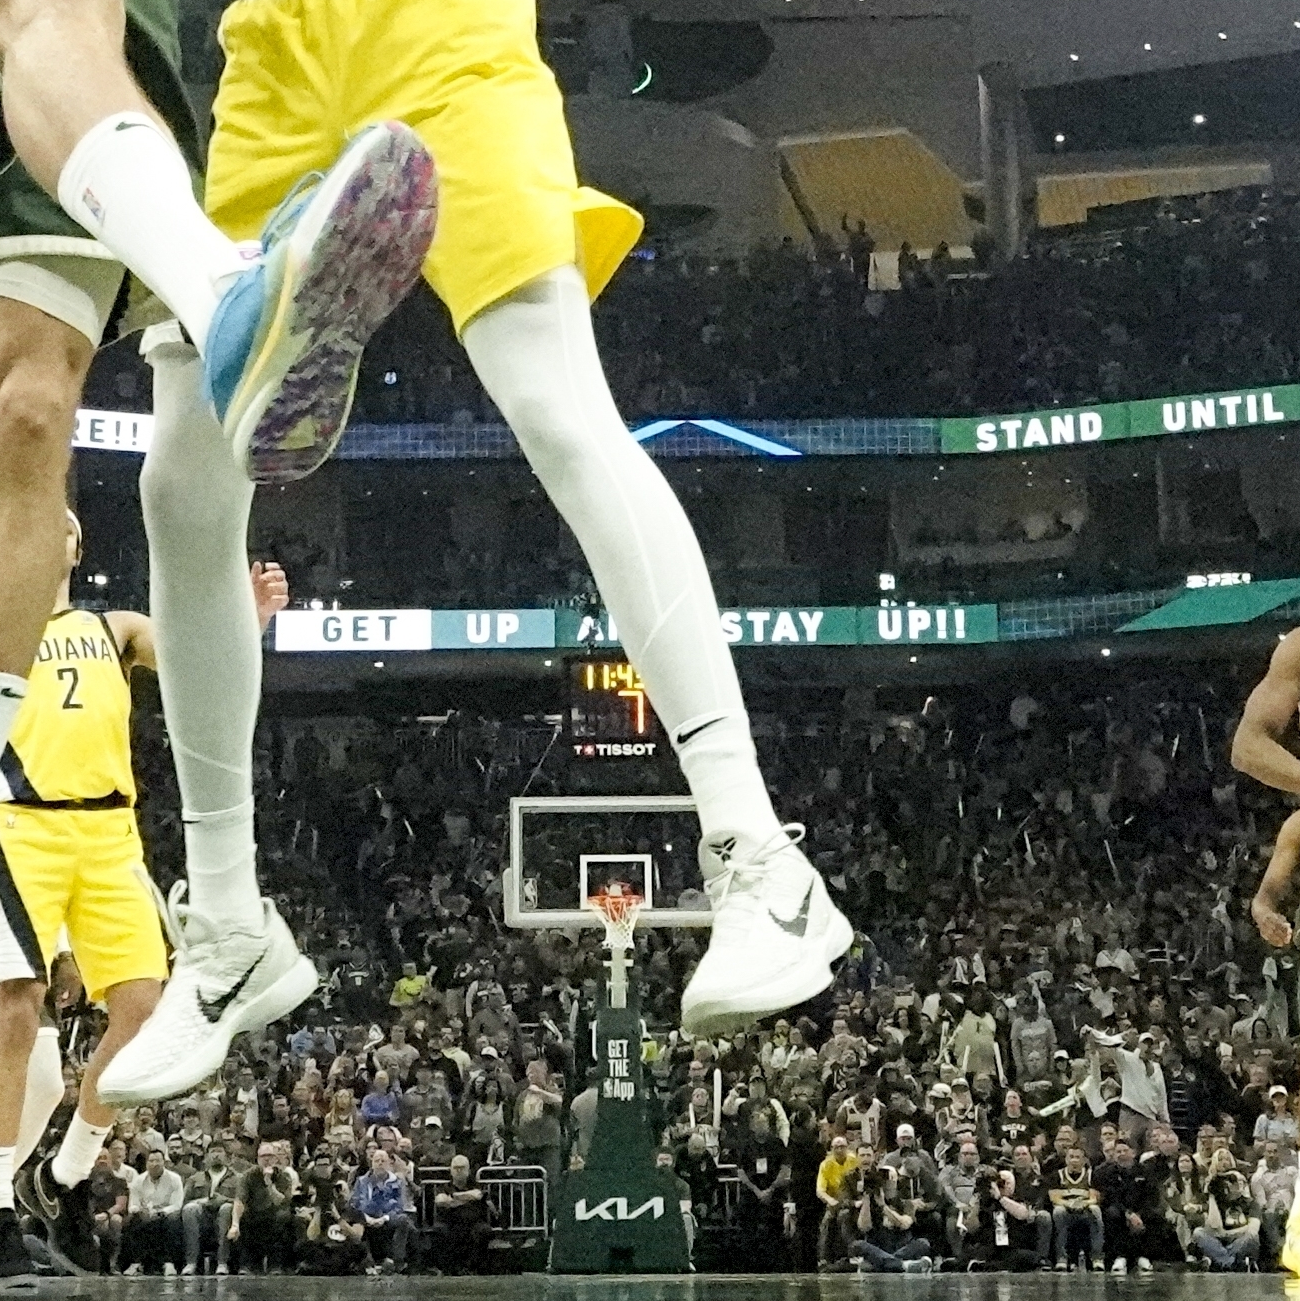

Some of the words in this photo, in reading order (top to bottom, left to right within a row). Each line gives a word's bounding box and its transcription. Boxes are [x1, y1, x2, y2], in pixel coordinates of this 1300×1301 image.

[975, 411, 1103, 452] STAND
[1162, 393, 1284, 431] UNTIL
[322, 614, 398, 642] GET
[466, 613, 520, 643] UP
[720, 611, 826, 643] STAY
[878, 608, 966, 641] UP!!
[38, 636, 113, 663] DIANA
[57, 667, 83, 710] 2
[617, 690, 644, 734] 7
[596, 743, 657, 756] TISSOT
[607, 1039, 629, 1058] GET
[608, 1059, 630, 1078] THE
[613, 1078, 635, 1101] App
